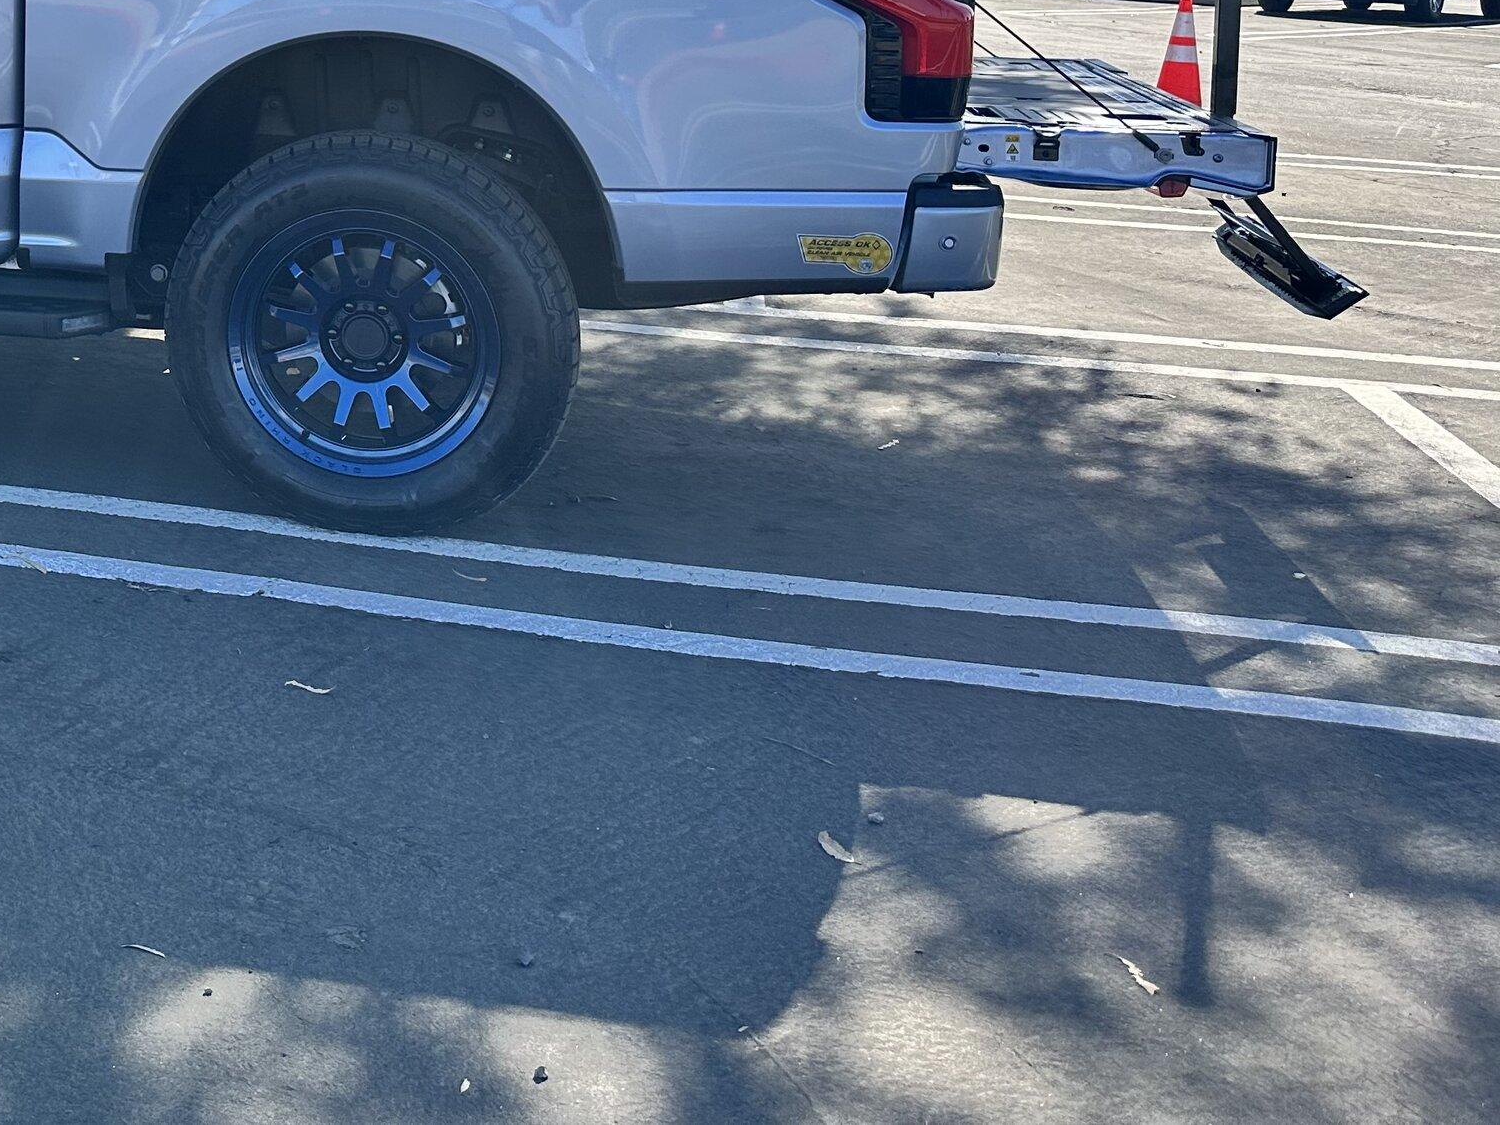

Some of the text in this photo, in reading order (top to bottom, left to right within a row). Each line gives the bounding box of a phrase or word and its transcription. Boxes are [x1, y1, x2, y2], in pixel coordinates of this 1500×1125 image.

[808, 239, 852, 247] ACCESS
[247, 397, 363, 475] BLACK RHINO
